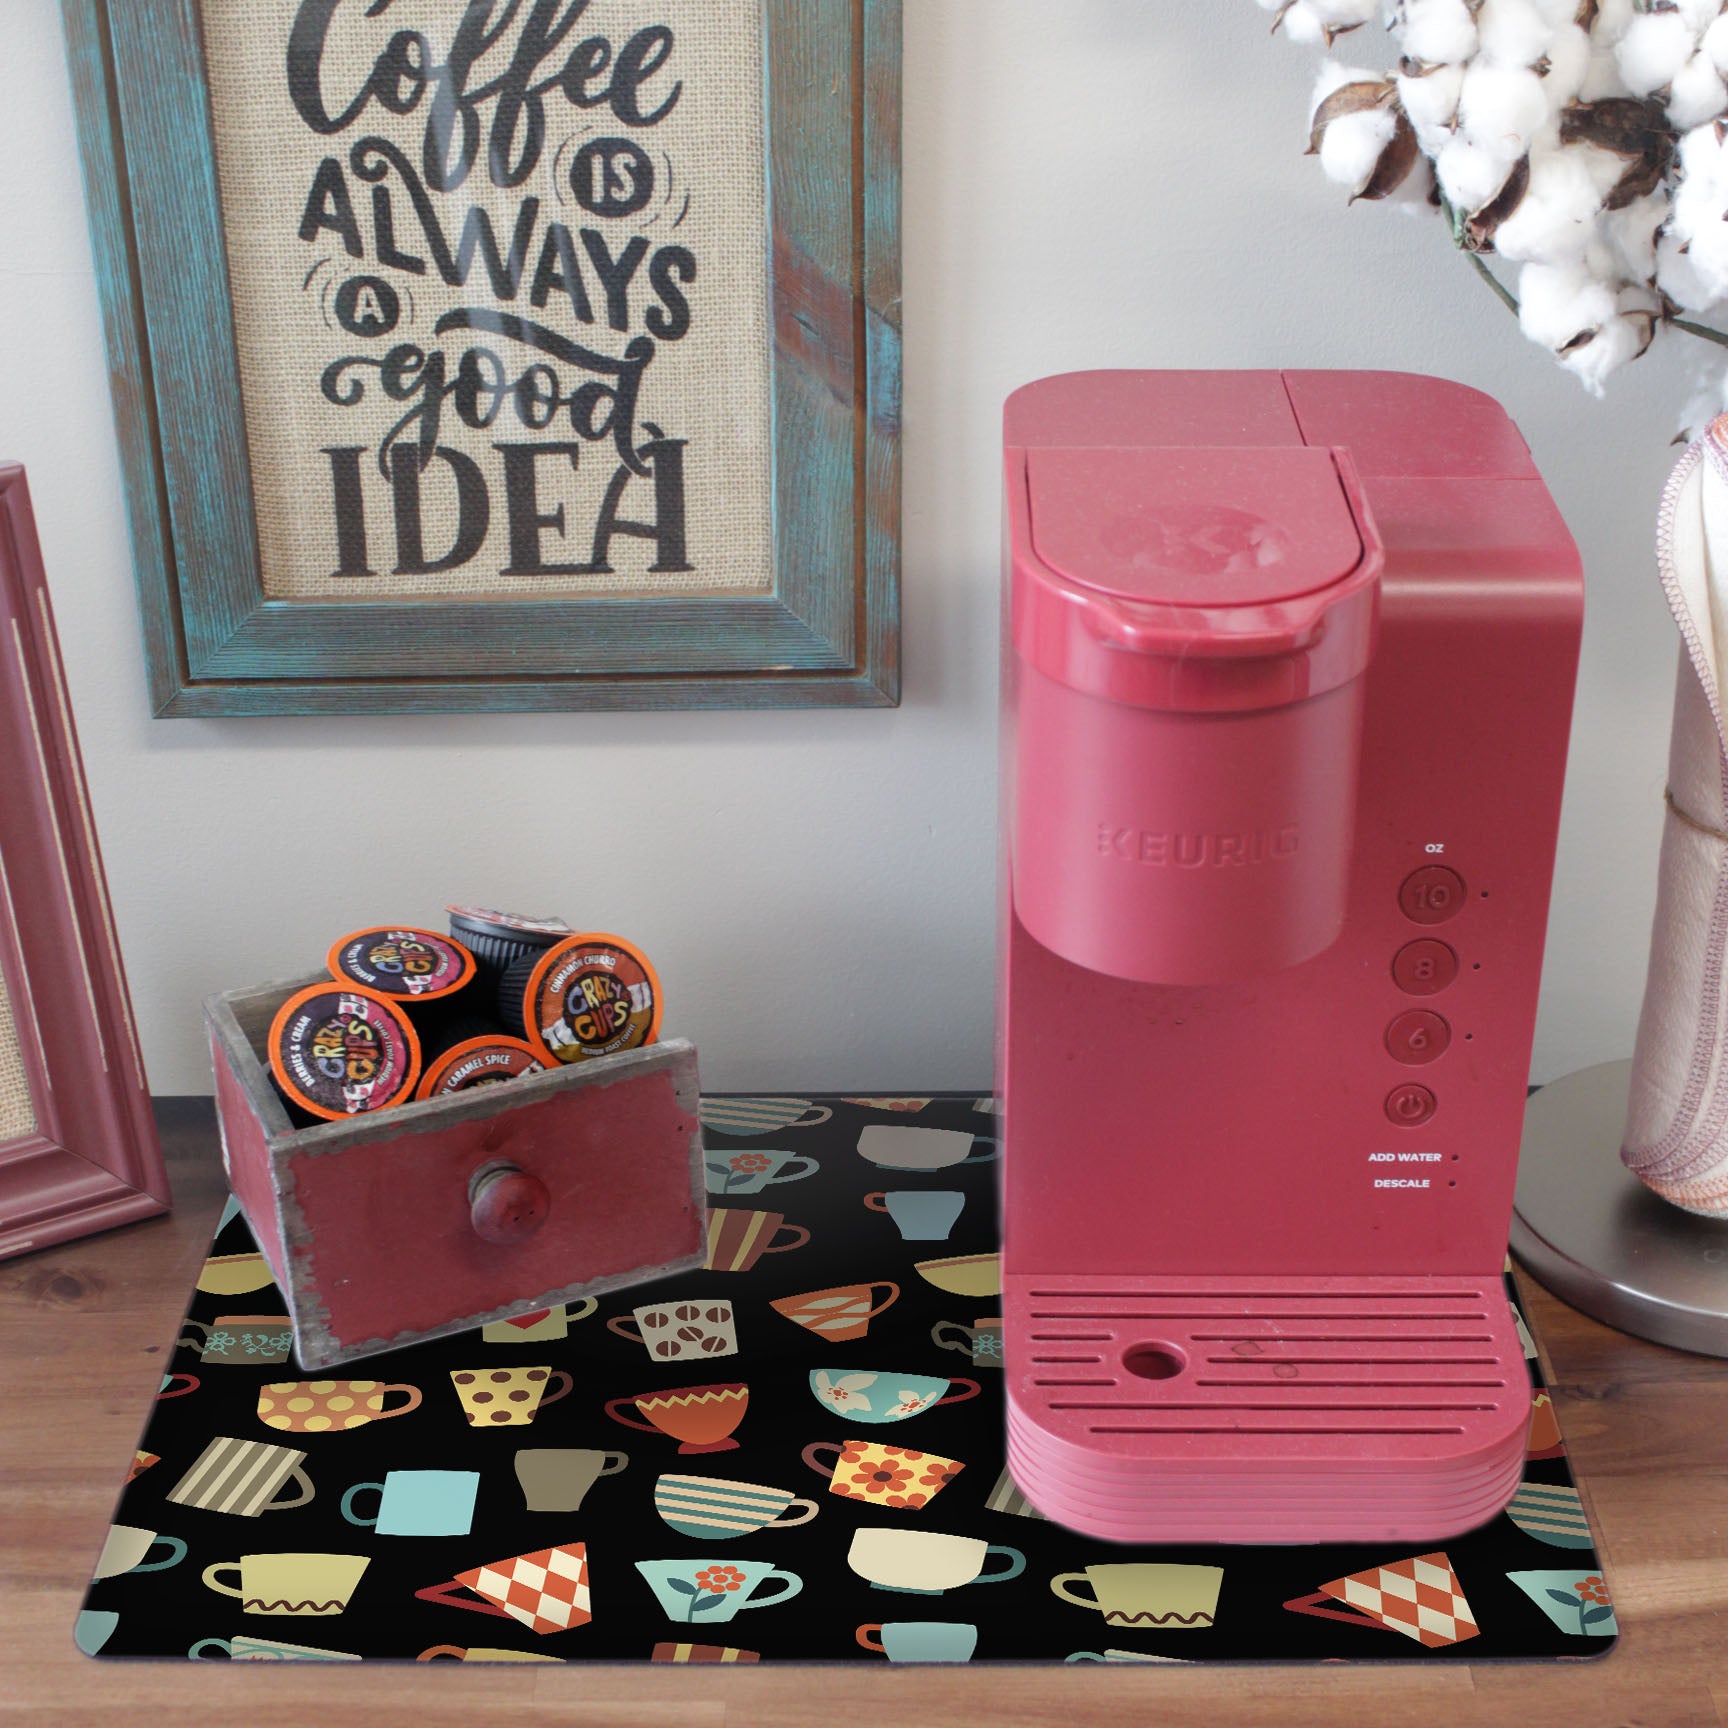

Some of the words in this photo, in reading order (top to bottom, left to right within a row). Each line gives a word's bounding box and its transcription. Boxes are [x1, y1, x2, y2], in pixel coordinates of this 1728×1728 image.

[287, 0, 682, 192] Coffee
[591, 152, 639, 202] IS
[298, 136, 697, 340] ALWAYS
[352, 286, 384, 324] A
[320, 307, 656, 482] good
[319, 423, 696, 577] IDEA
[1097, 822, 1299, 869] KEURIG
[1425, 843, 1445, 854] OZ
[1416, 883, 1450, 909] 10
[369, 941, 404, 974] CRAZY
[400, 941, 433, 973] CUPS
[550, 958, 584, 993] CINNAMON
[584, 954, 617, 967] CHURRO
[1414, 958, 1434, 980] 8
[567, 975, 622, 1015] CRAZY
[290, 1015, 312, 1043] CREAM
[574, 1001, 629, 1040] CUPS
[1408, 1027, 1428, 1049] 6
[312, 1019, 347, 1079] CRAZY
[345, 1020, 379, 1080] CUPS
[290, 1053, 316, 1088] BERRIES
[447, 1057, 485, 1087] CARAMEL
[485, 1054, 511, 1065] SPICE
[1368, 1153, 1396, 1163] ADD
[1397, 1153, 1442, 1163] WATER
[1374, 1179, 1430, 1189] DESCALE
